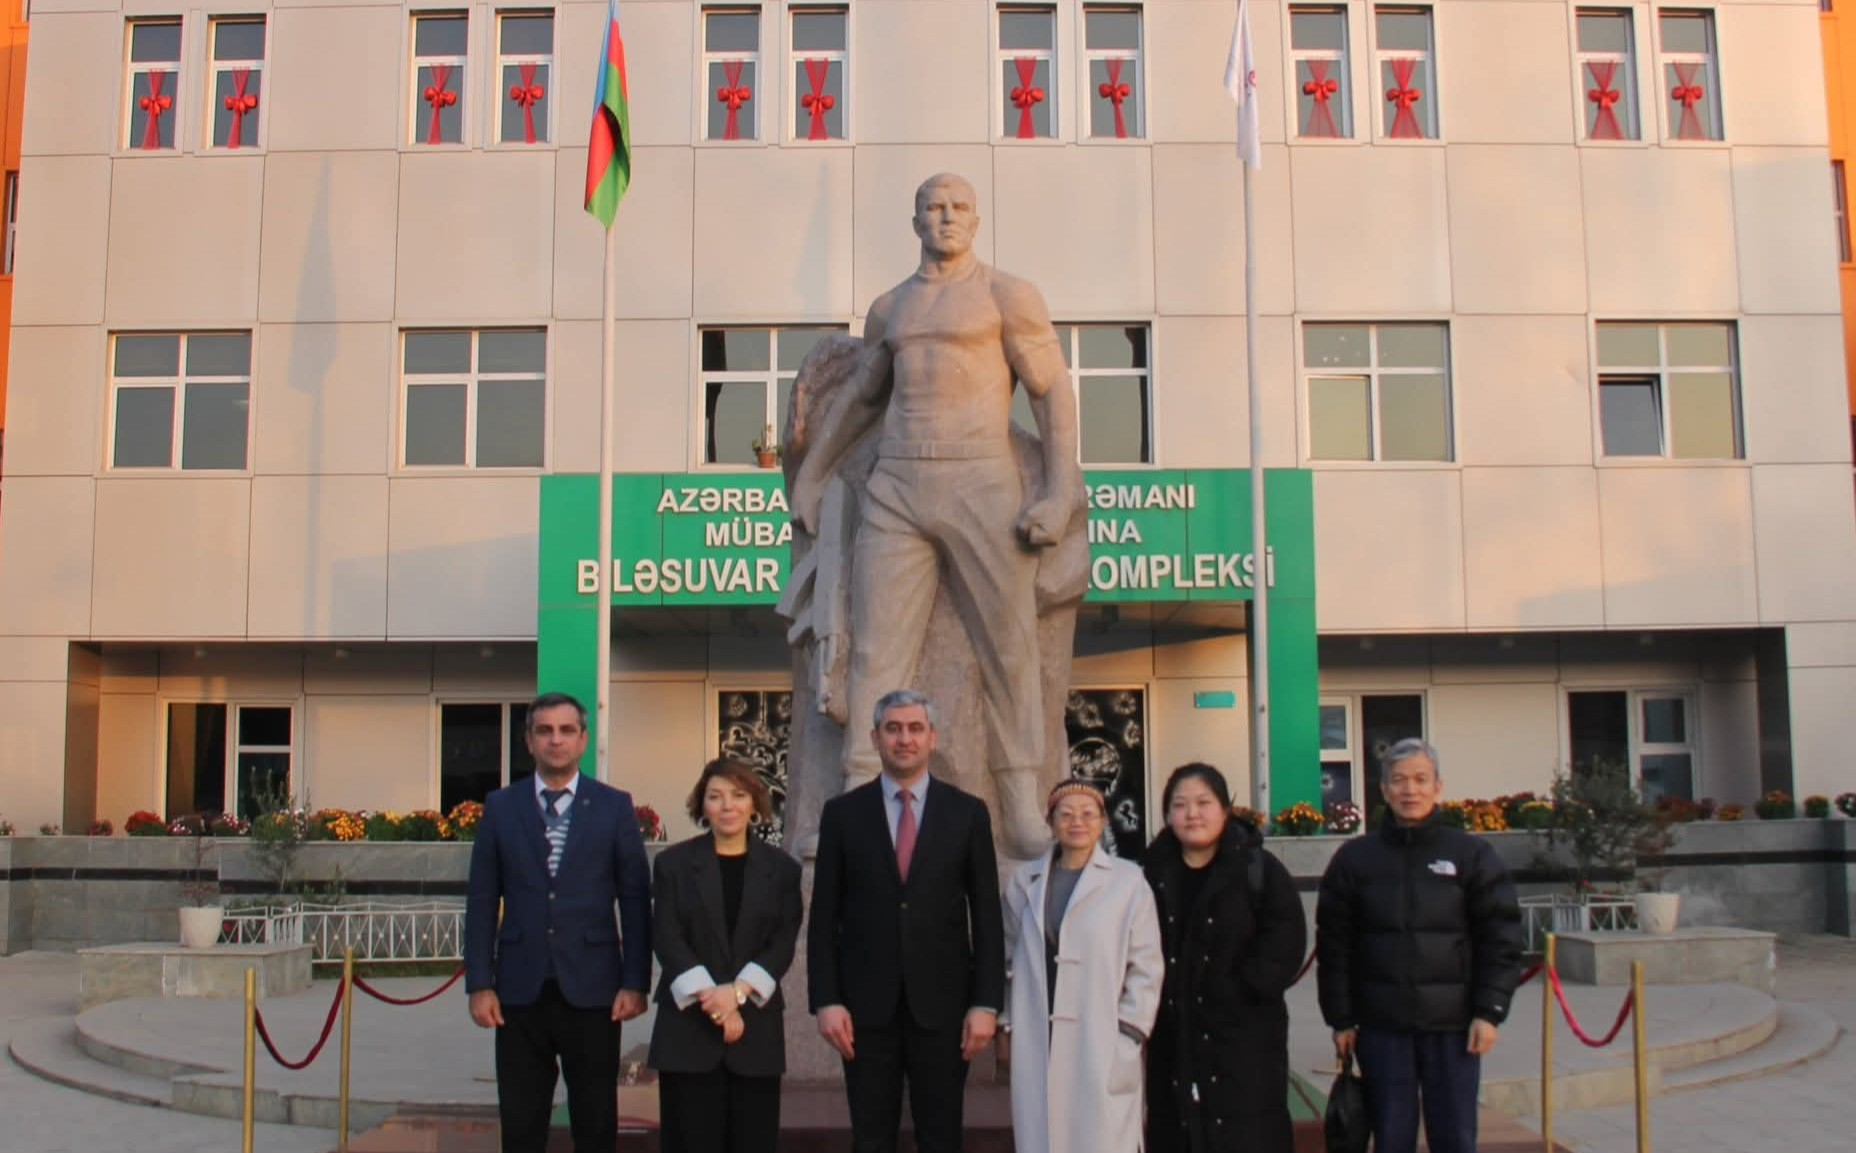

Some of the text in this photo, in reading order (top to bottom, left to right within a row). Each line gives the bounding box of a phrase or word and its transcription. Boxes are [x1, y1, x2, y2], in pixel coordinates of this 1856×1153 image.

[705, 517, 793, 547] MÜBA
[577, 546, 1275, 594] BLƏSUVAR OMPLEKSİ
